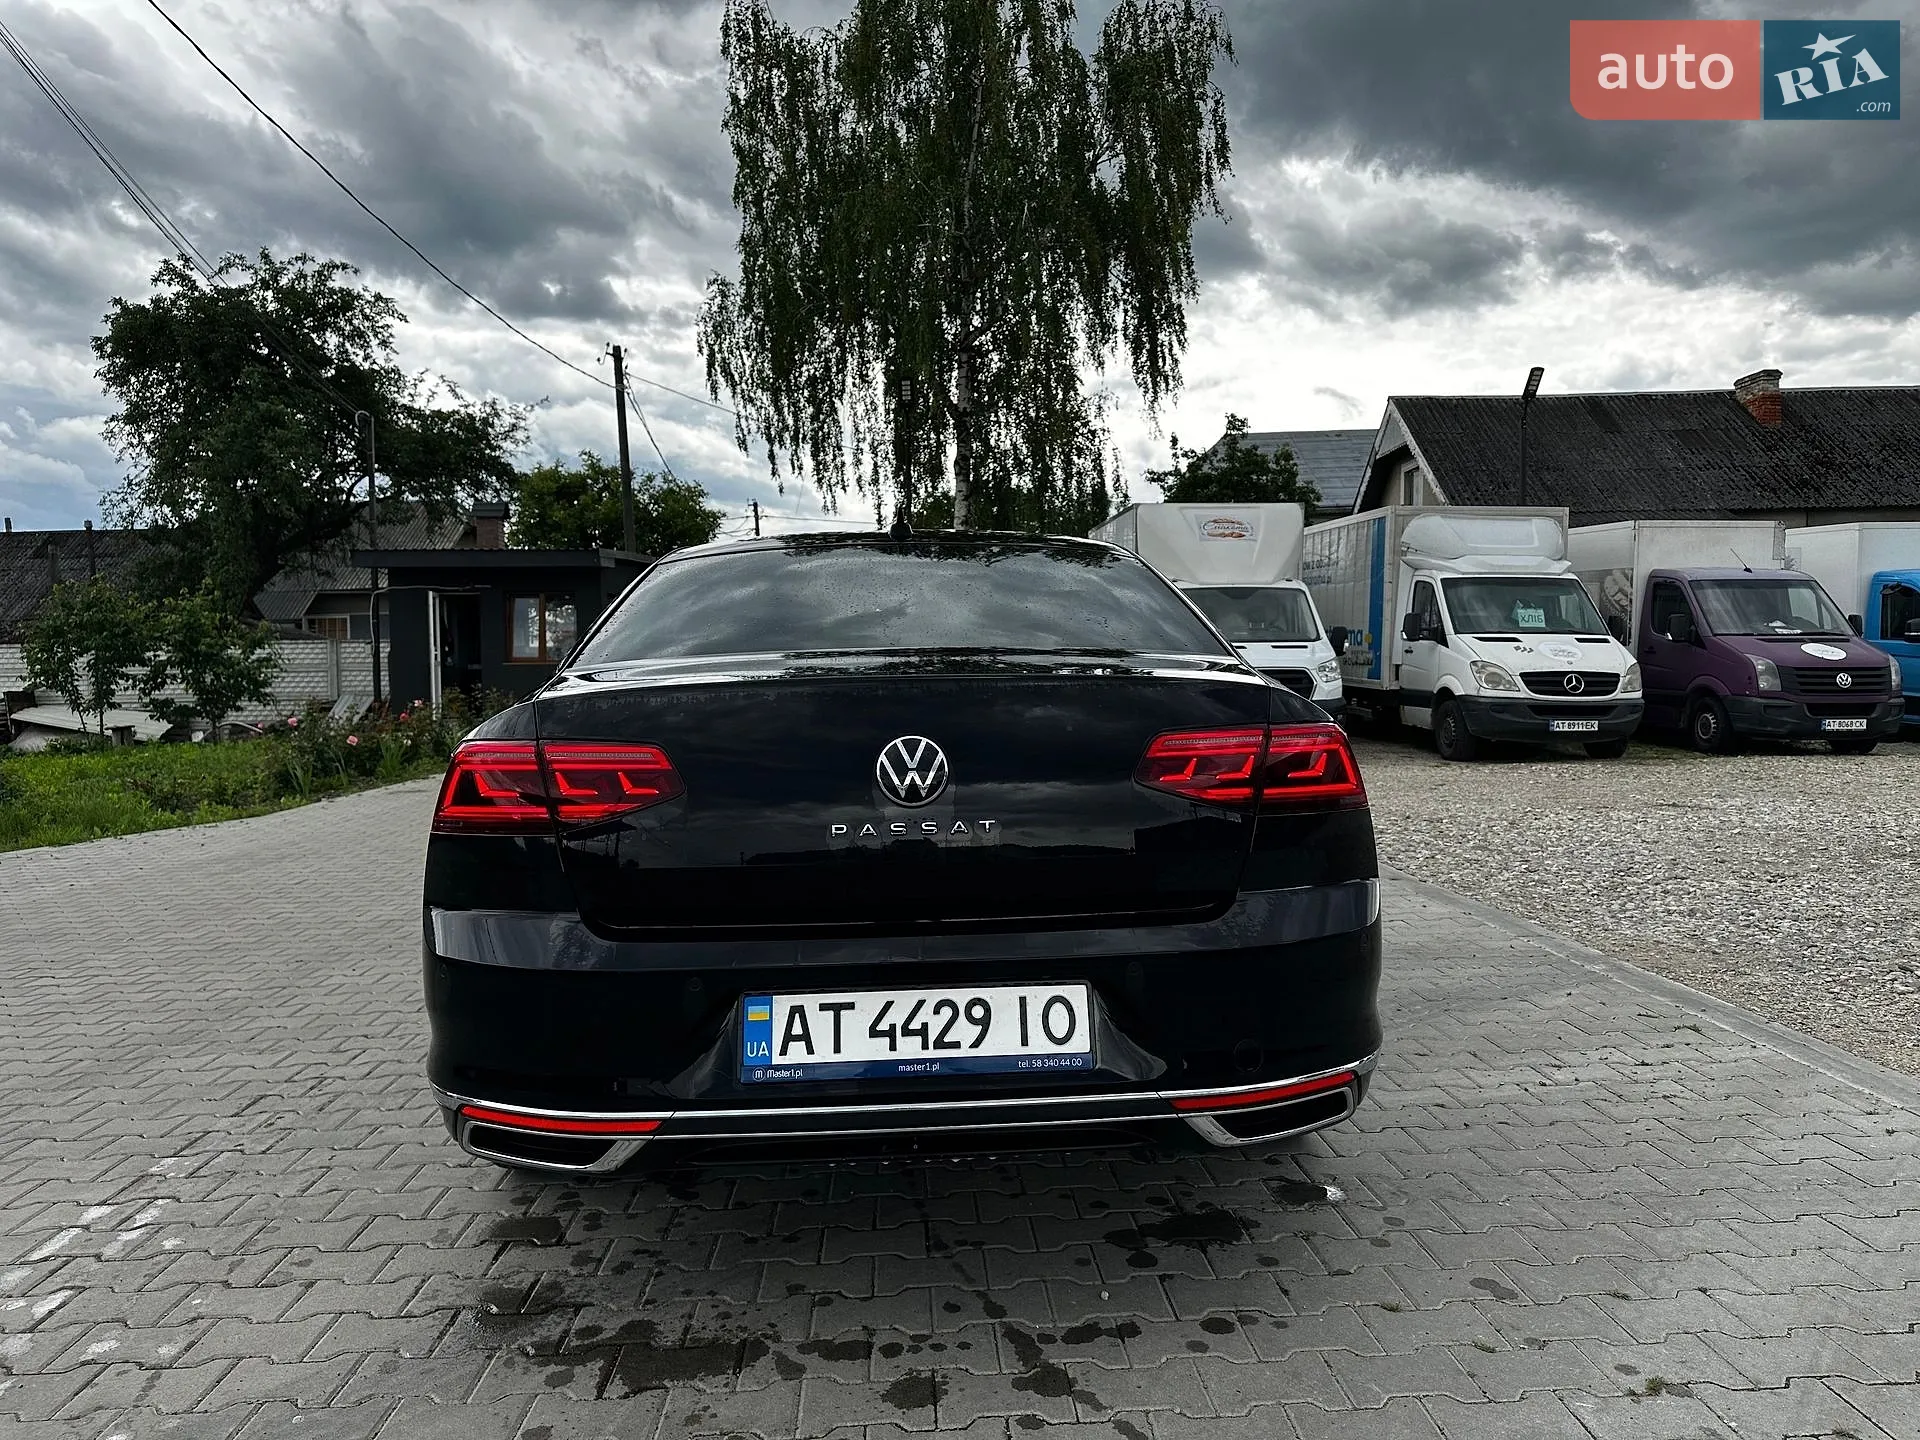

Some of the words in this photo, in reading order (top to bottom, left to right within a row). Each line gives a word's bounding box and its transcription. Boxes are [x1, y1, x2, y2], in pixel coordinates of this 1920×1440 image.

[1520, 614, 1543, 623] ХЛІБ
[831, 819, 996, 837] PASSAT
[778, 1001, 856, 1057] AT
[868, 997, 993, 1052] 4429
[747, 1041, 770, 1057] UA
[898, 1062, 940, 1072] master1.pl
[1018, 1060, 1031, 1068] tel.
[1031, 1059, 1042, 1068] 58
[1043, 1059, 1059, 1067] 340
[1059, 1058, 1070, 1067] 44
[1071, 1058, 1083, 1066] 00
